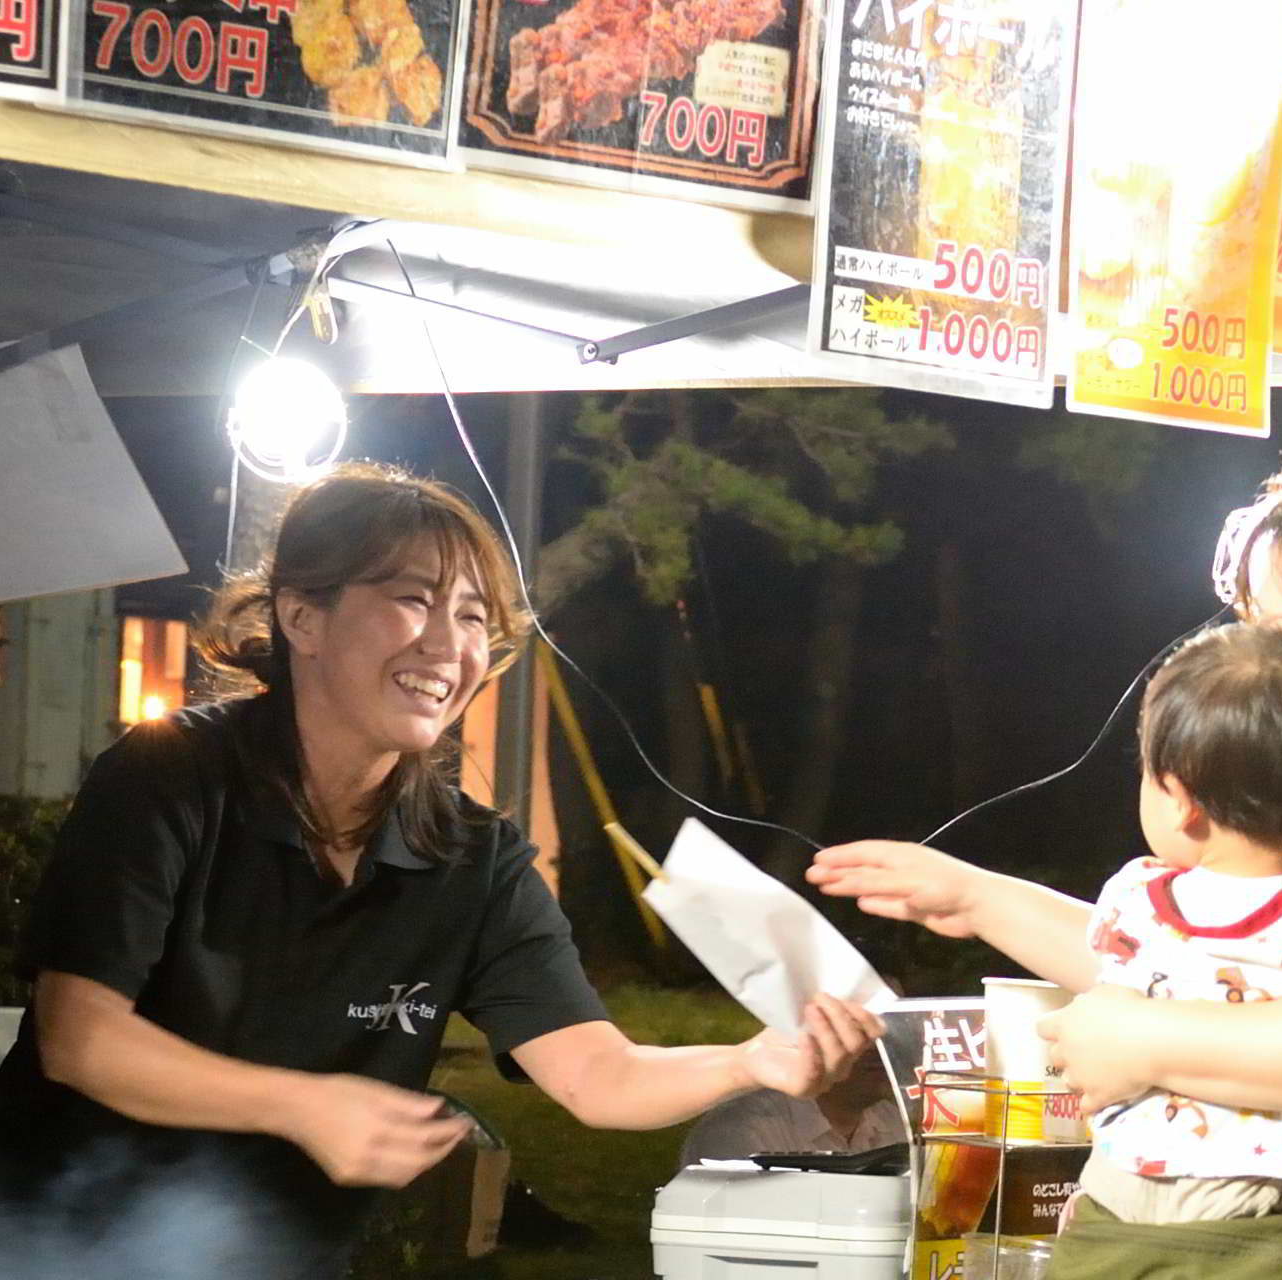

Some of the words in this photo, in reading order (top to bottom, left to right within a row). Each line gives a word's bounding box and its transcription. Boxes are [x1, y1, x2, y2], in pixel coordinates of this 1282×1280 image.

[92, 2, 267, 97] 700円
[641, 92, 766, 164] 700円
[933, 243, 1043, 308] 500円
